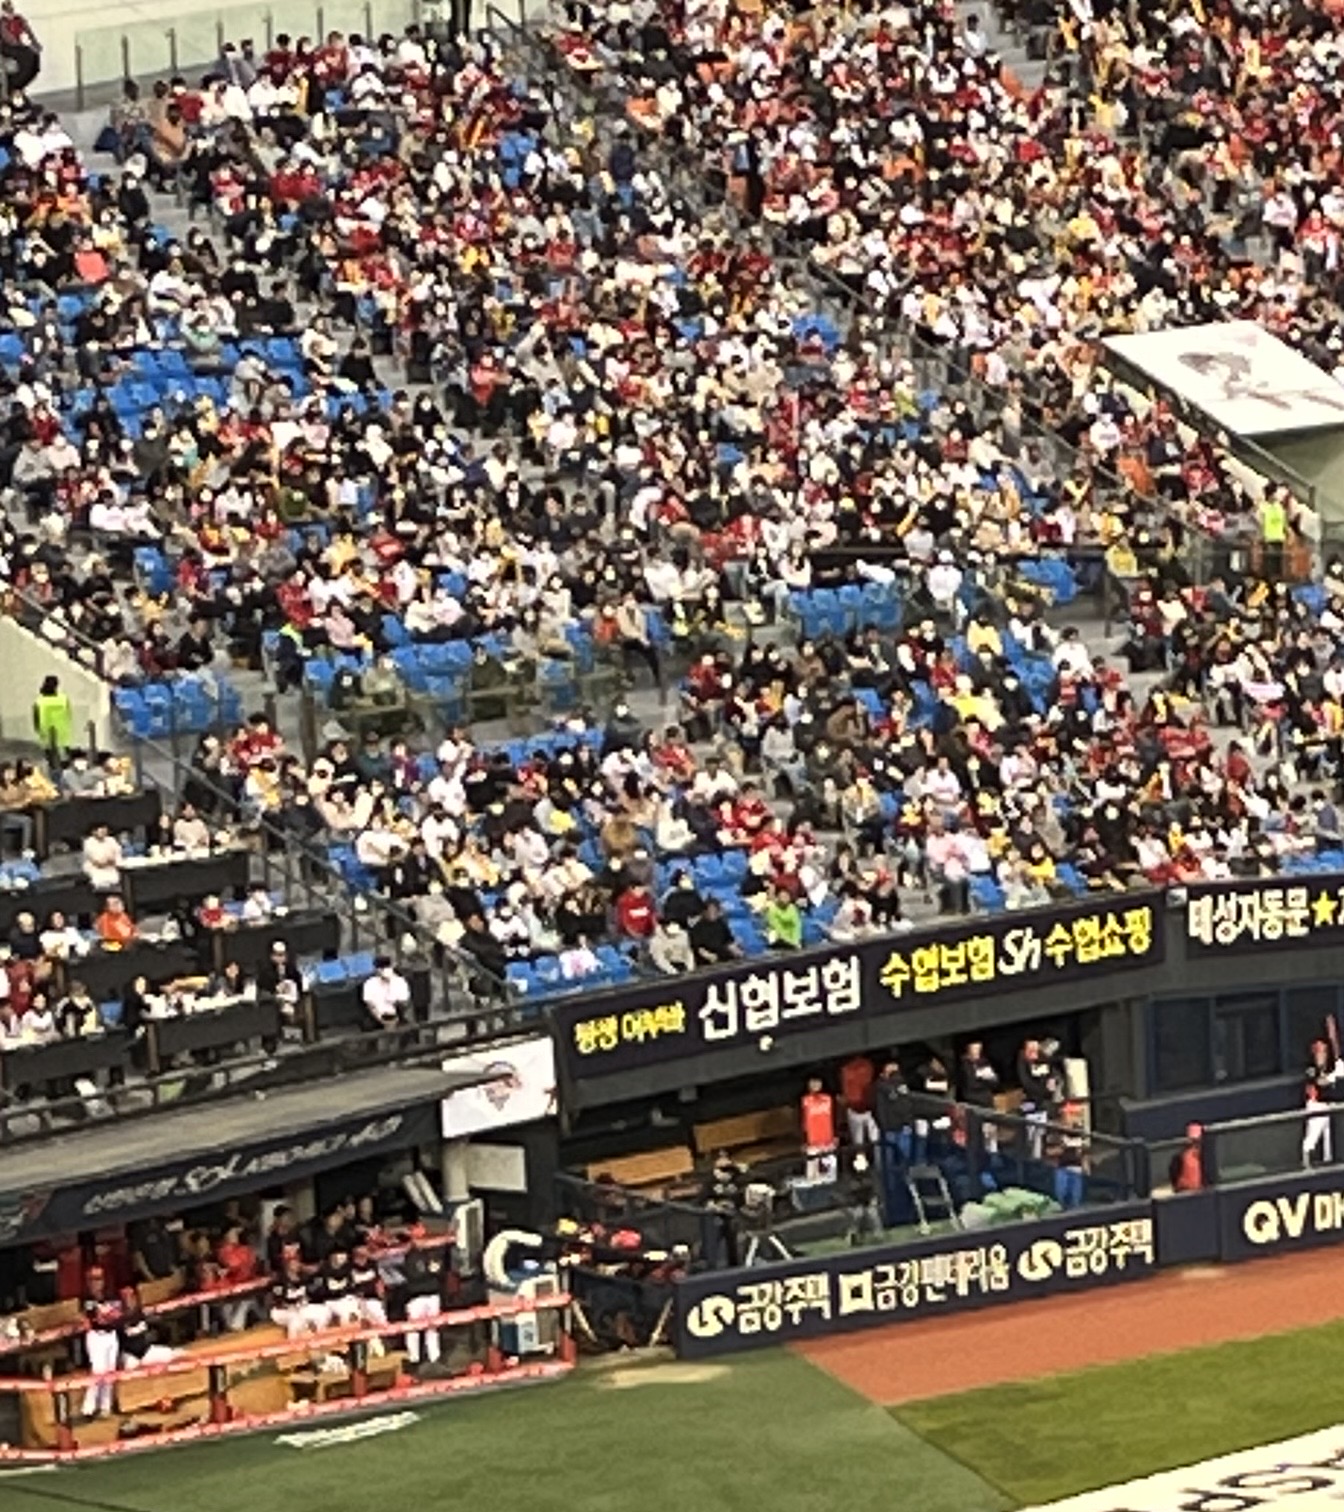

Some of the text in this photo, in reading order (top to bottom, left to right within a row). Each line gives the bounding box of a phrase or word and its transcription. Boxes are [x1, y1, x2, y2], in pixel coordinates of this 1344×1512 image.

[880, 936, 995, 998] 수협보험
[1045, 906, 1151, 968] 수협쇼핑
[698, 955, 861, 1040] 신협보험
[1065, 1218, 1155, 1278] 금강주택
[1243, 1192, 1312, 1244] QV
[736, 1271, 831, 1334] 금강주택
